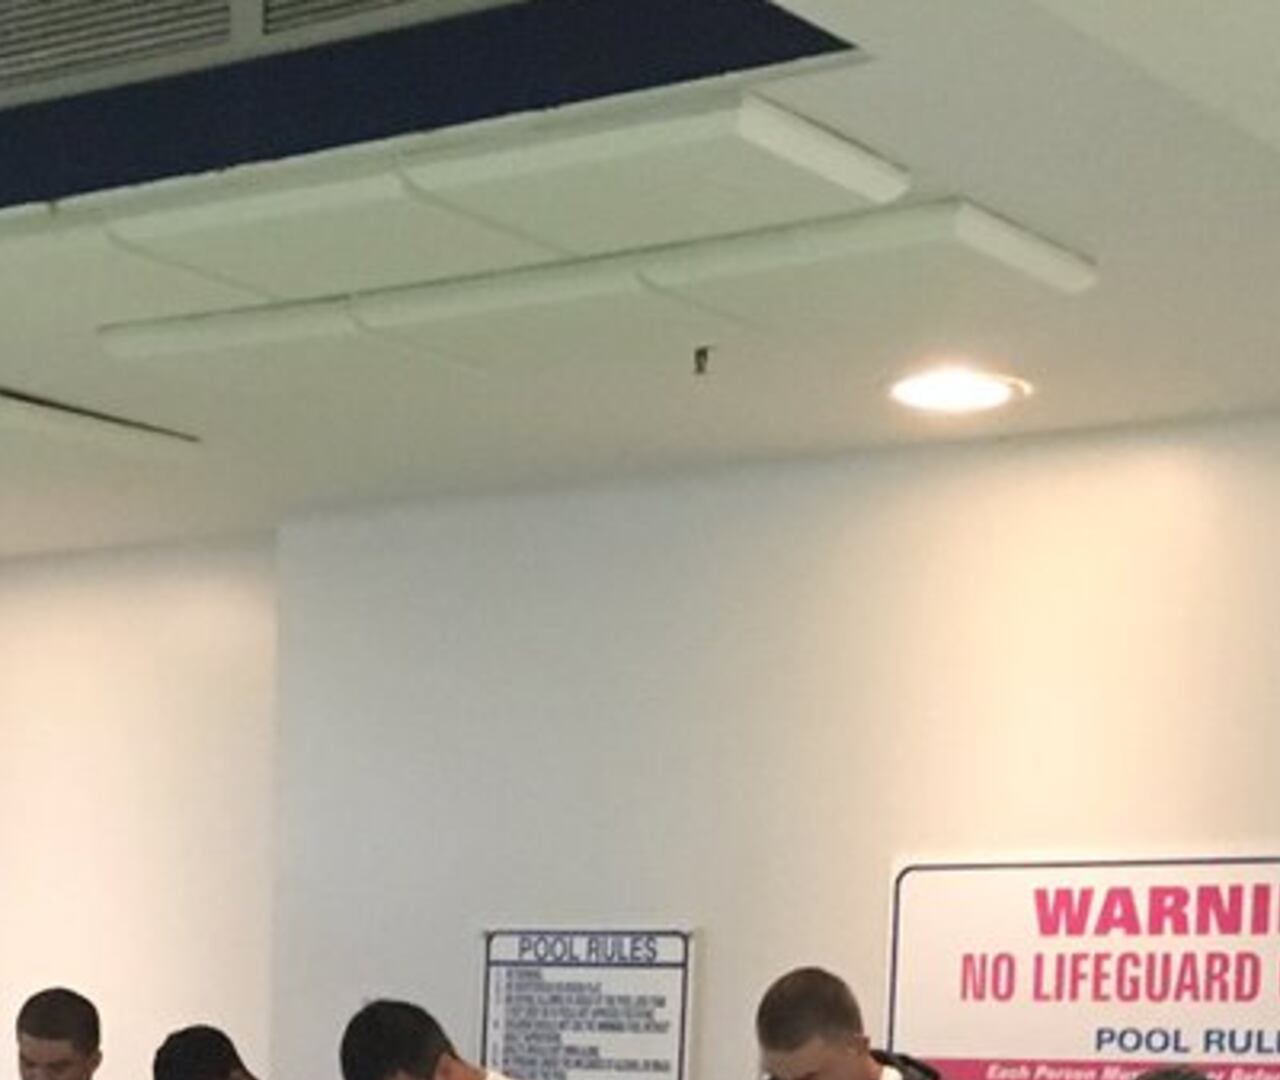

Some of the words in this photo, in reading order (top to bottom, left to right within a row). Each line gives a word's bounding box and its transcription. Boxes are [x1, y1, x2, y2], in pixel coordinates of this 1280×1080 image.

[518, 936, 579, 962] POOL
[587, 936, 658, 962] RULES
[960, 952, 1016, 1002] NO
[1033, 951, 1262, 1002] LIFEGUARD
[1095, 1027, 1190, 1054] POOL
